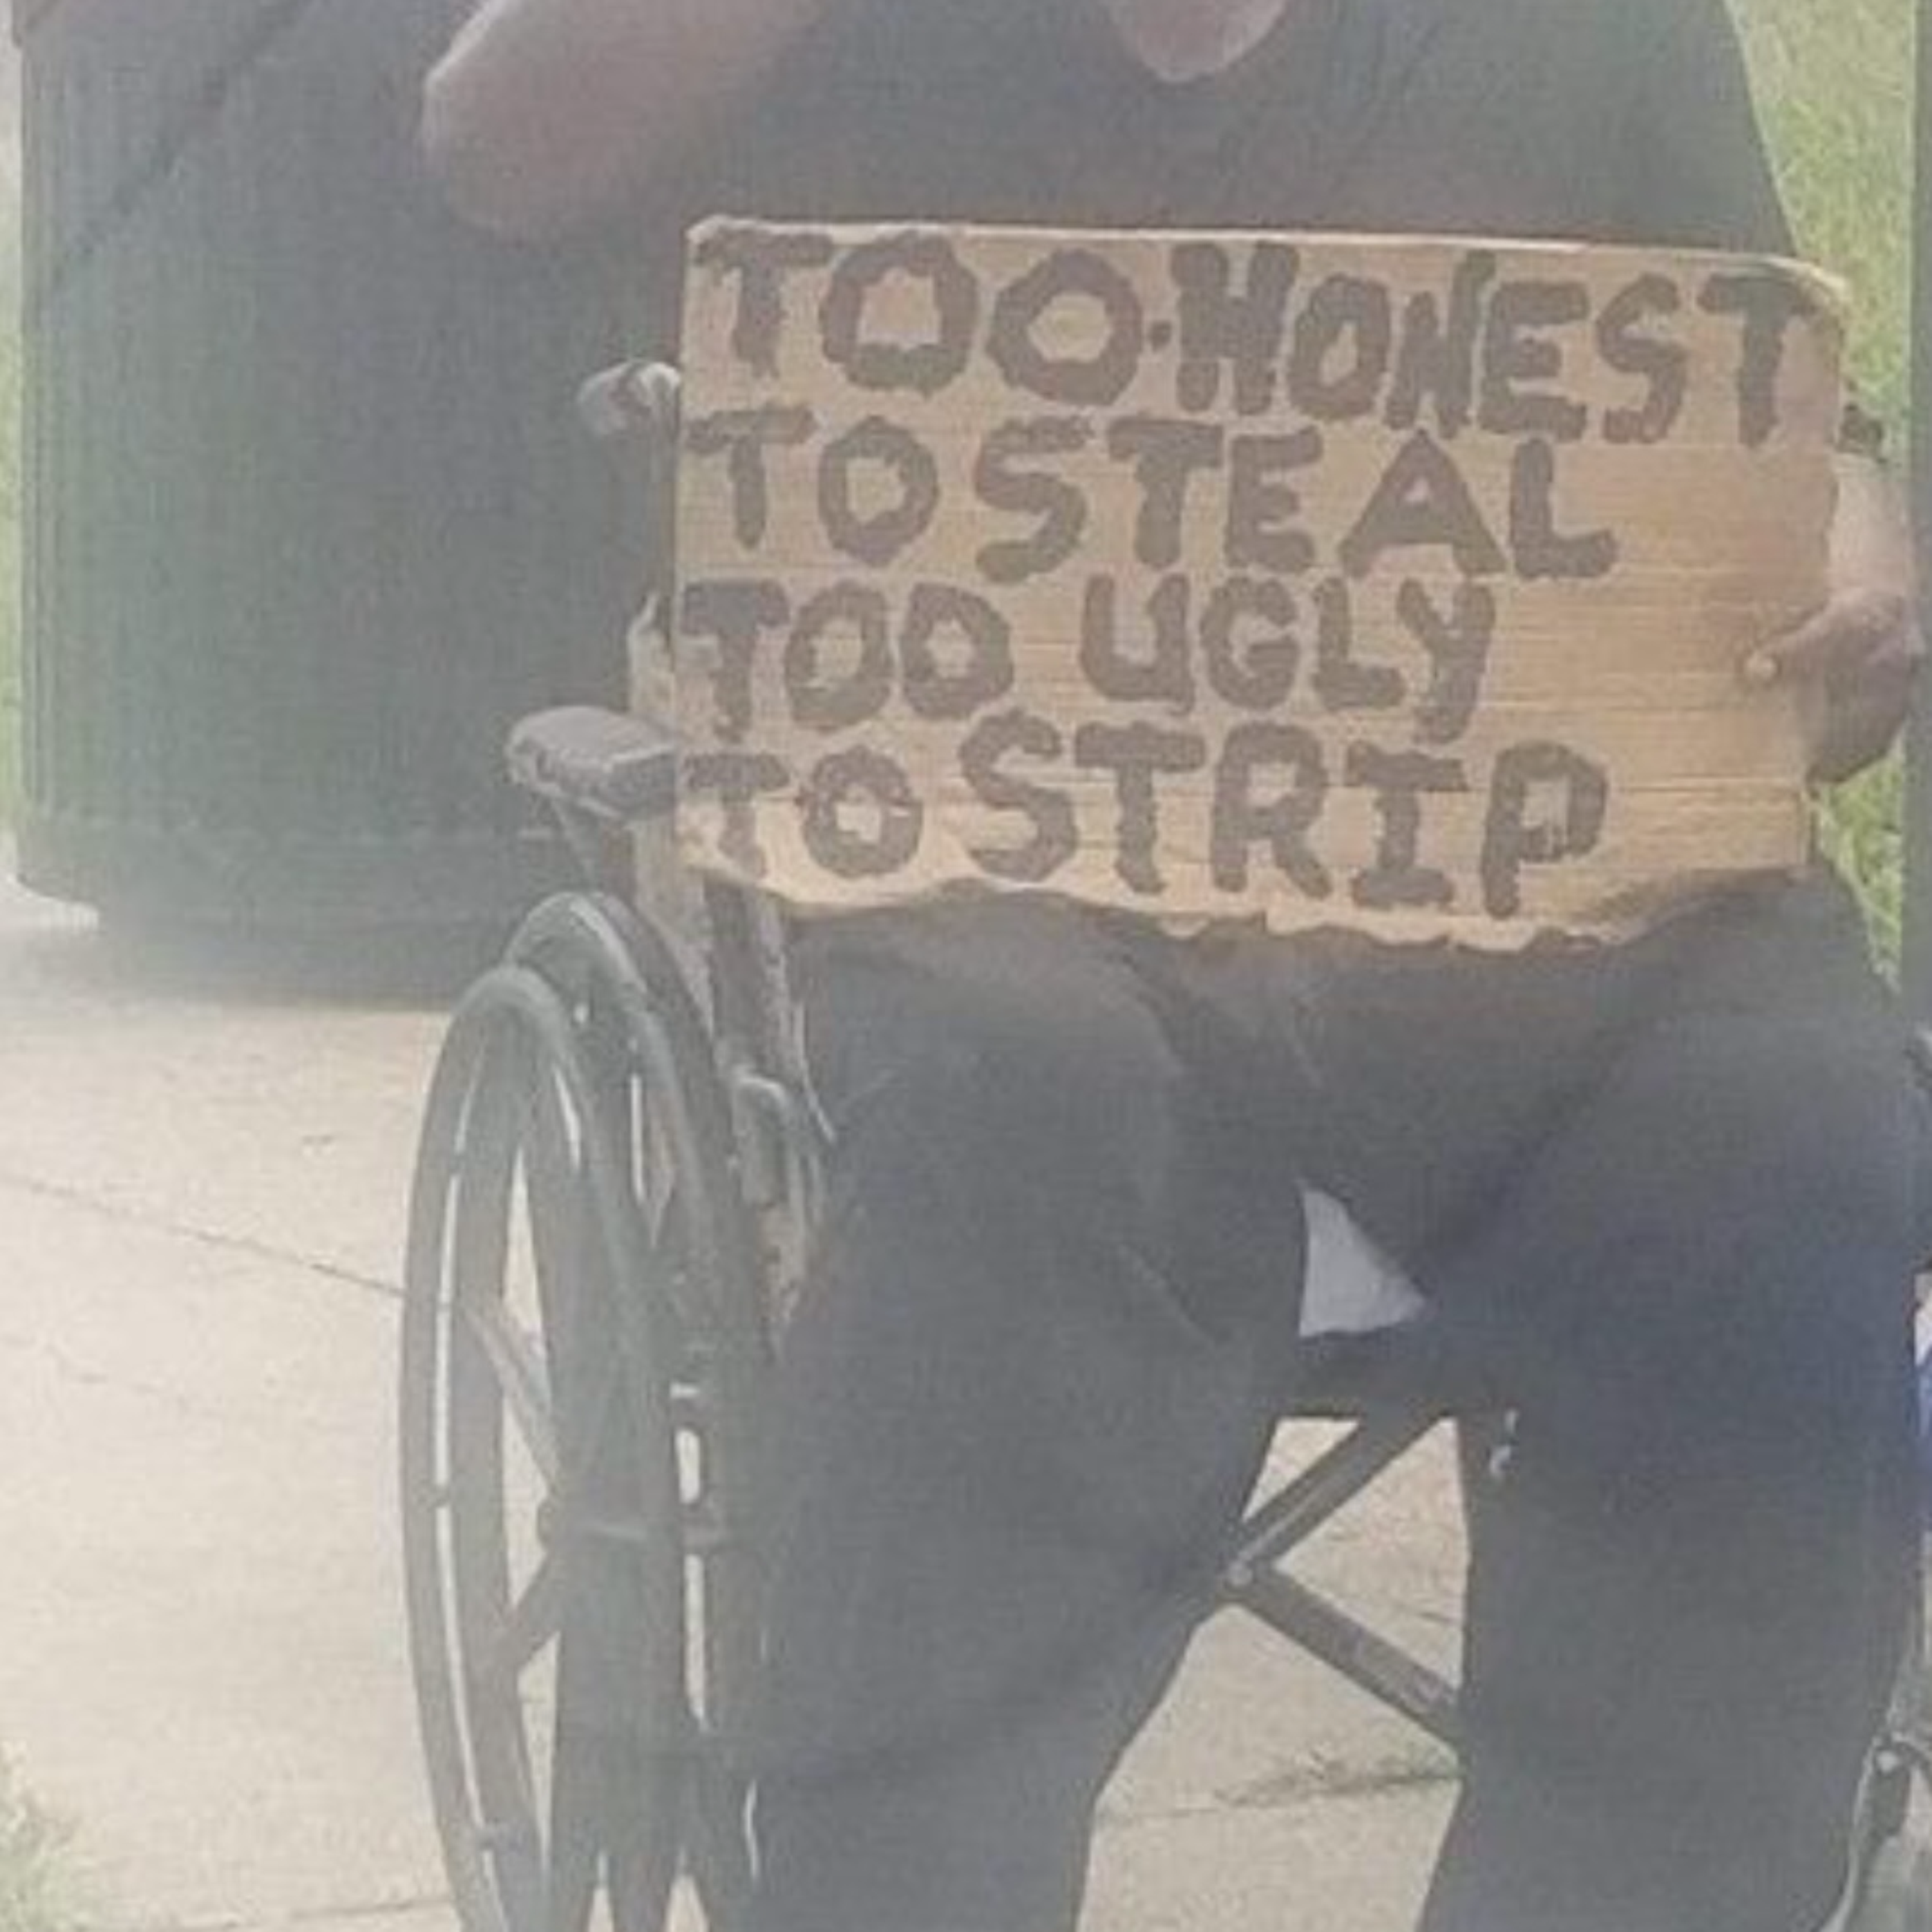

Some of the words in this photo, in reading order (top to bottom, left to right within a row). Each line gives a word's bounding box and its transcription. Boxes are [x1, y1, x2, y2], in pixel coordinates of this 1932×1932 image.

[694, 227, 1144, 407] TOO
[1170, 238, 1818, 448] HONEST
[686, 406, 939, 567] TO
[974, 415, 1618, 583] STEAL
[683, 578, 1016, 743] TOO
[1079, 573, 1497, 744] UGLY
[683, 744, 923, 879] TO
[958, 707, 1609, 920] STRIP
